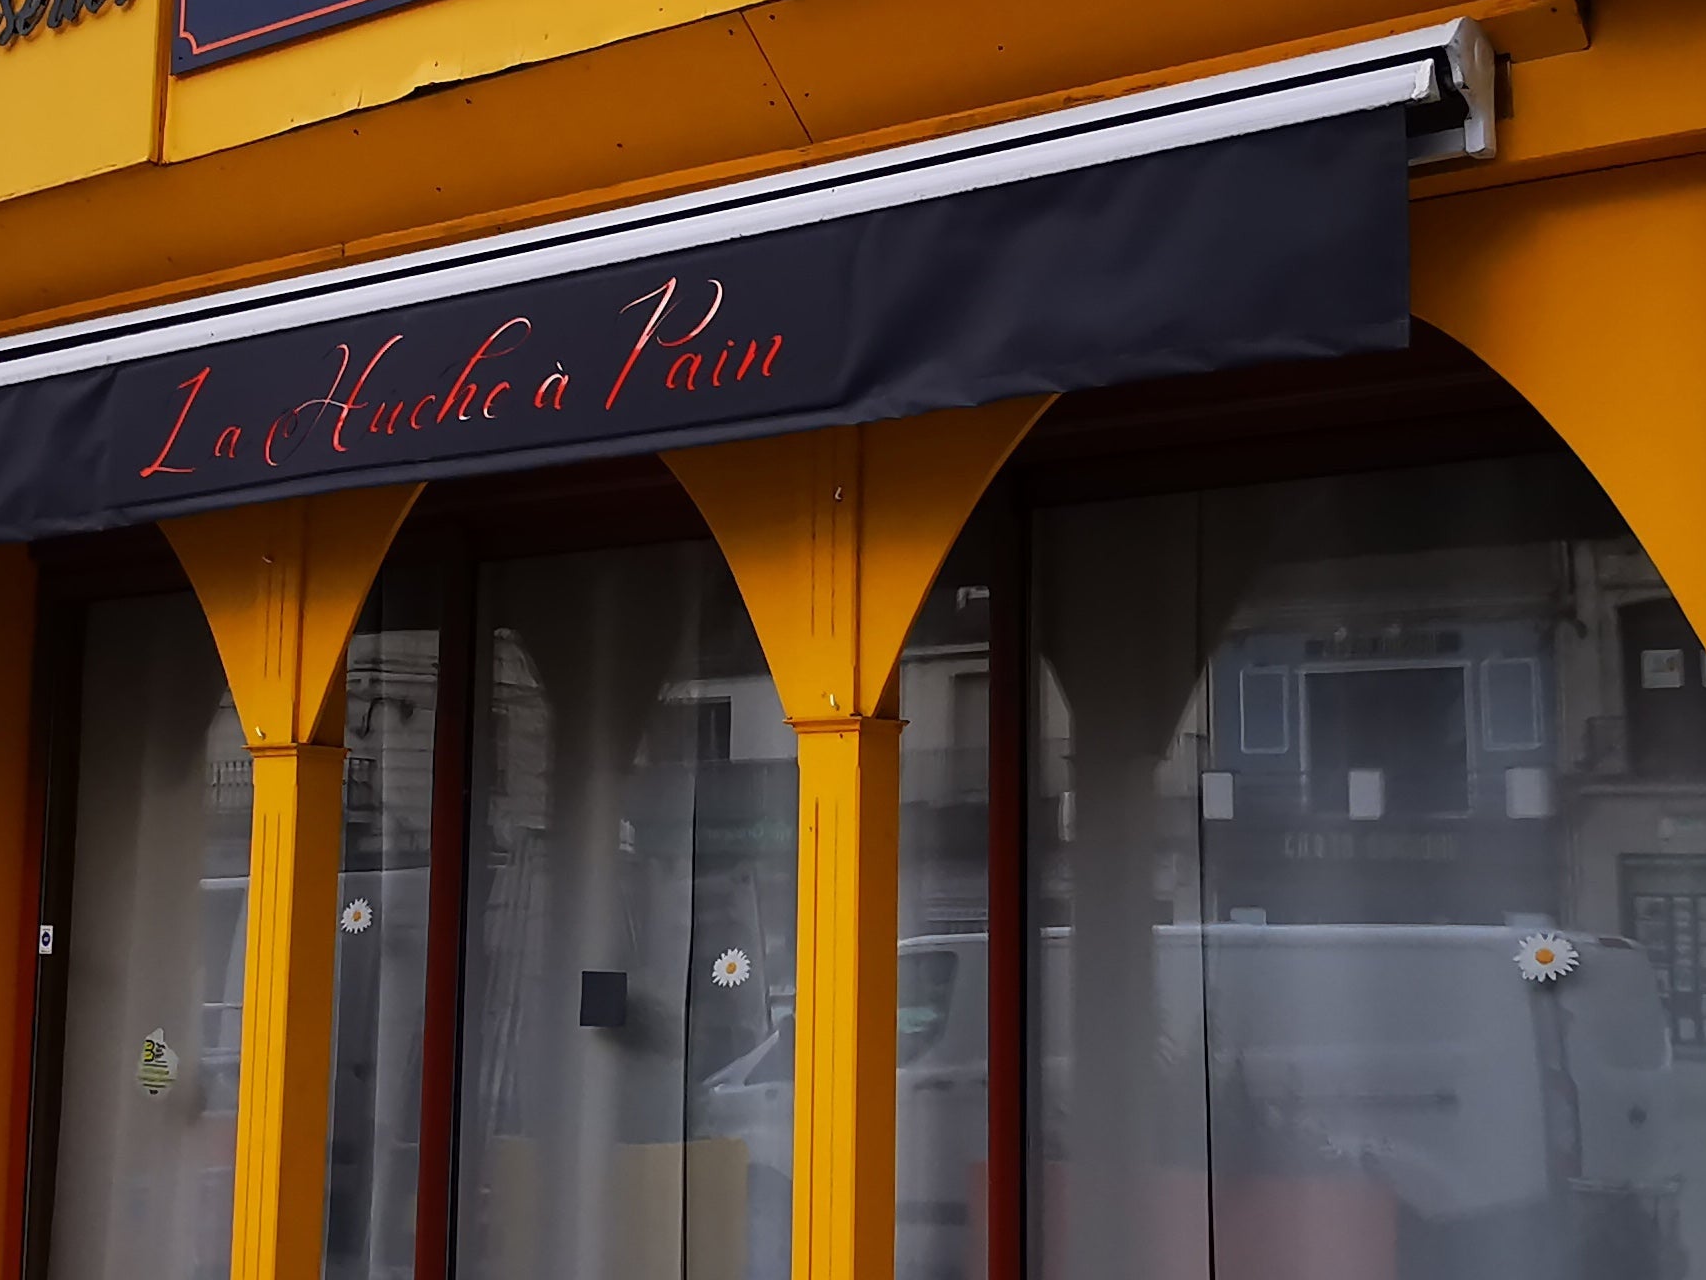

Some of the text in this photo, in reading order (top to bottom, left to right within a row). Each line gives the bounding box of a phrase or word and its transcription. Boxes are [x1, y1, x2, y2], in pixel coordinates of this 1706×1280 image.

[139, 276, 783, 477] La Huche à Pain
